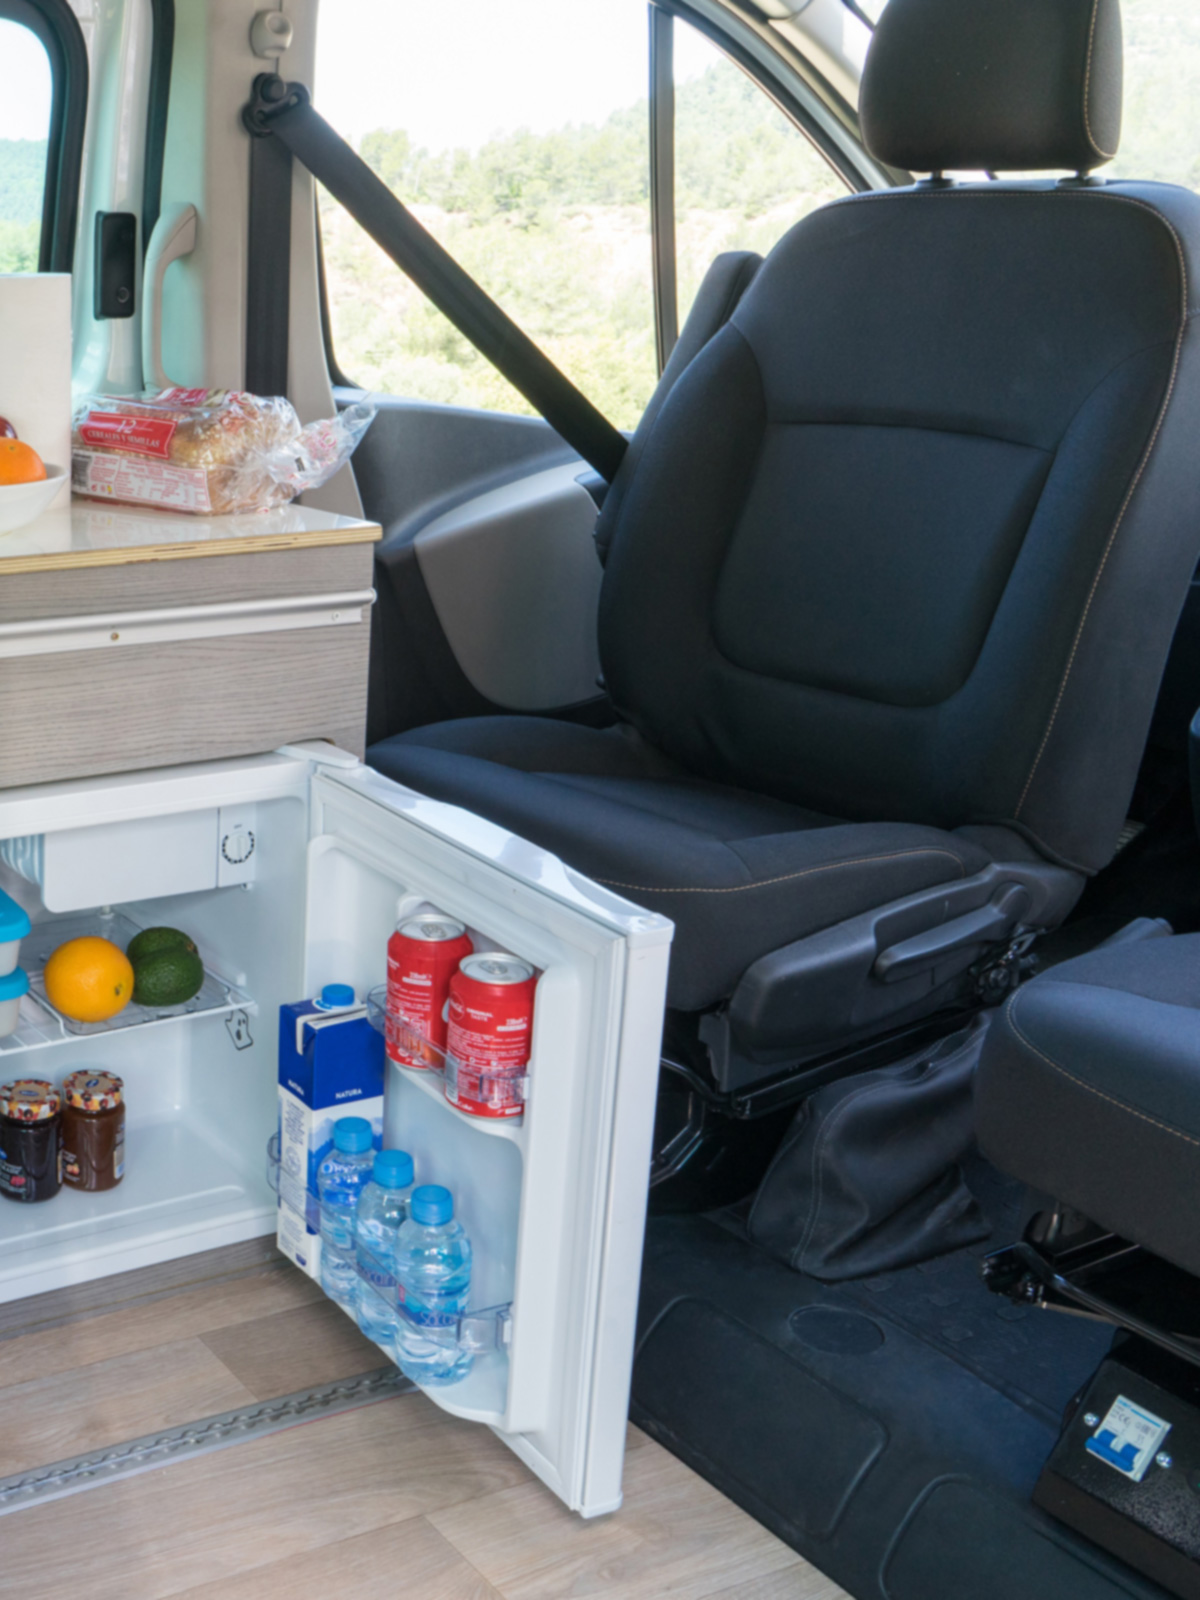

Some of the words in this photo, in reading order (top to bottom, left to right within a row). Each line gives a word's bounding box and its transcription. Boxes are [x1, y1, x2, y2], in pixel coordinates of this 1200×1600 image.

[116, 420, 137, 434] 12
[87, 430, 120, 440] CEREALES
[127, 436, 160, 448] SEMILLAS
[335, 1088, 362, 1099] NATURA
